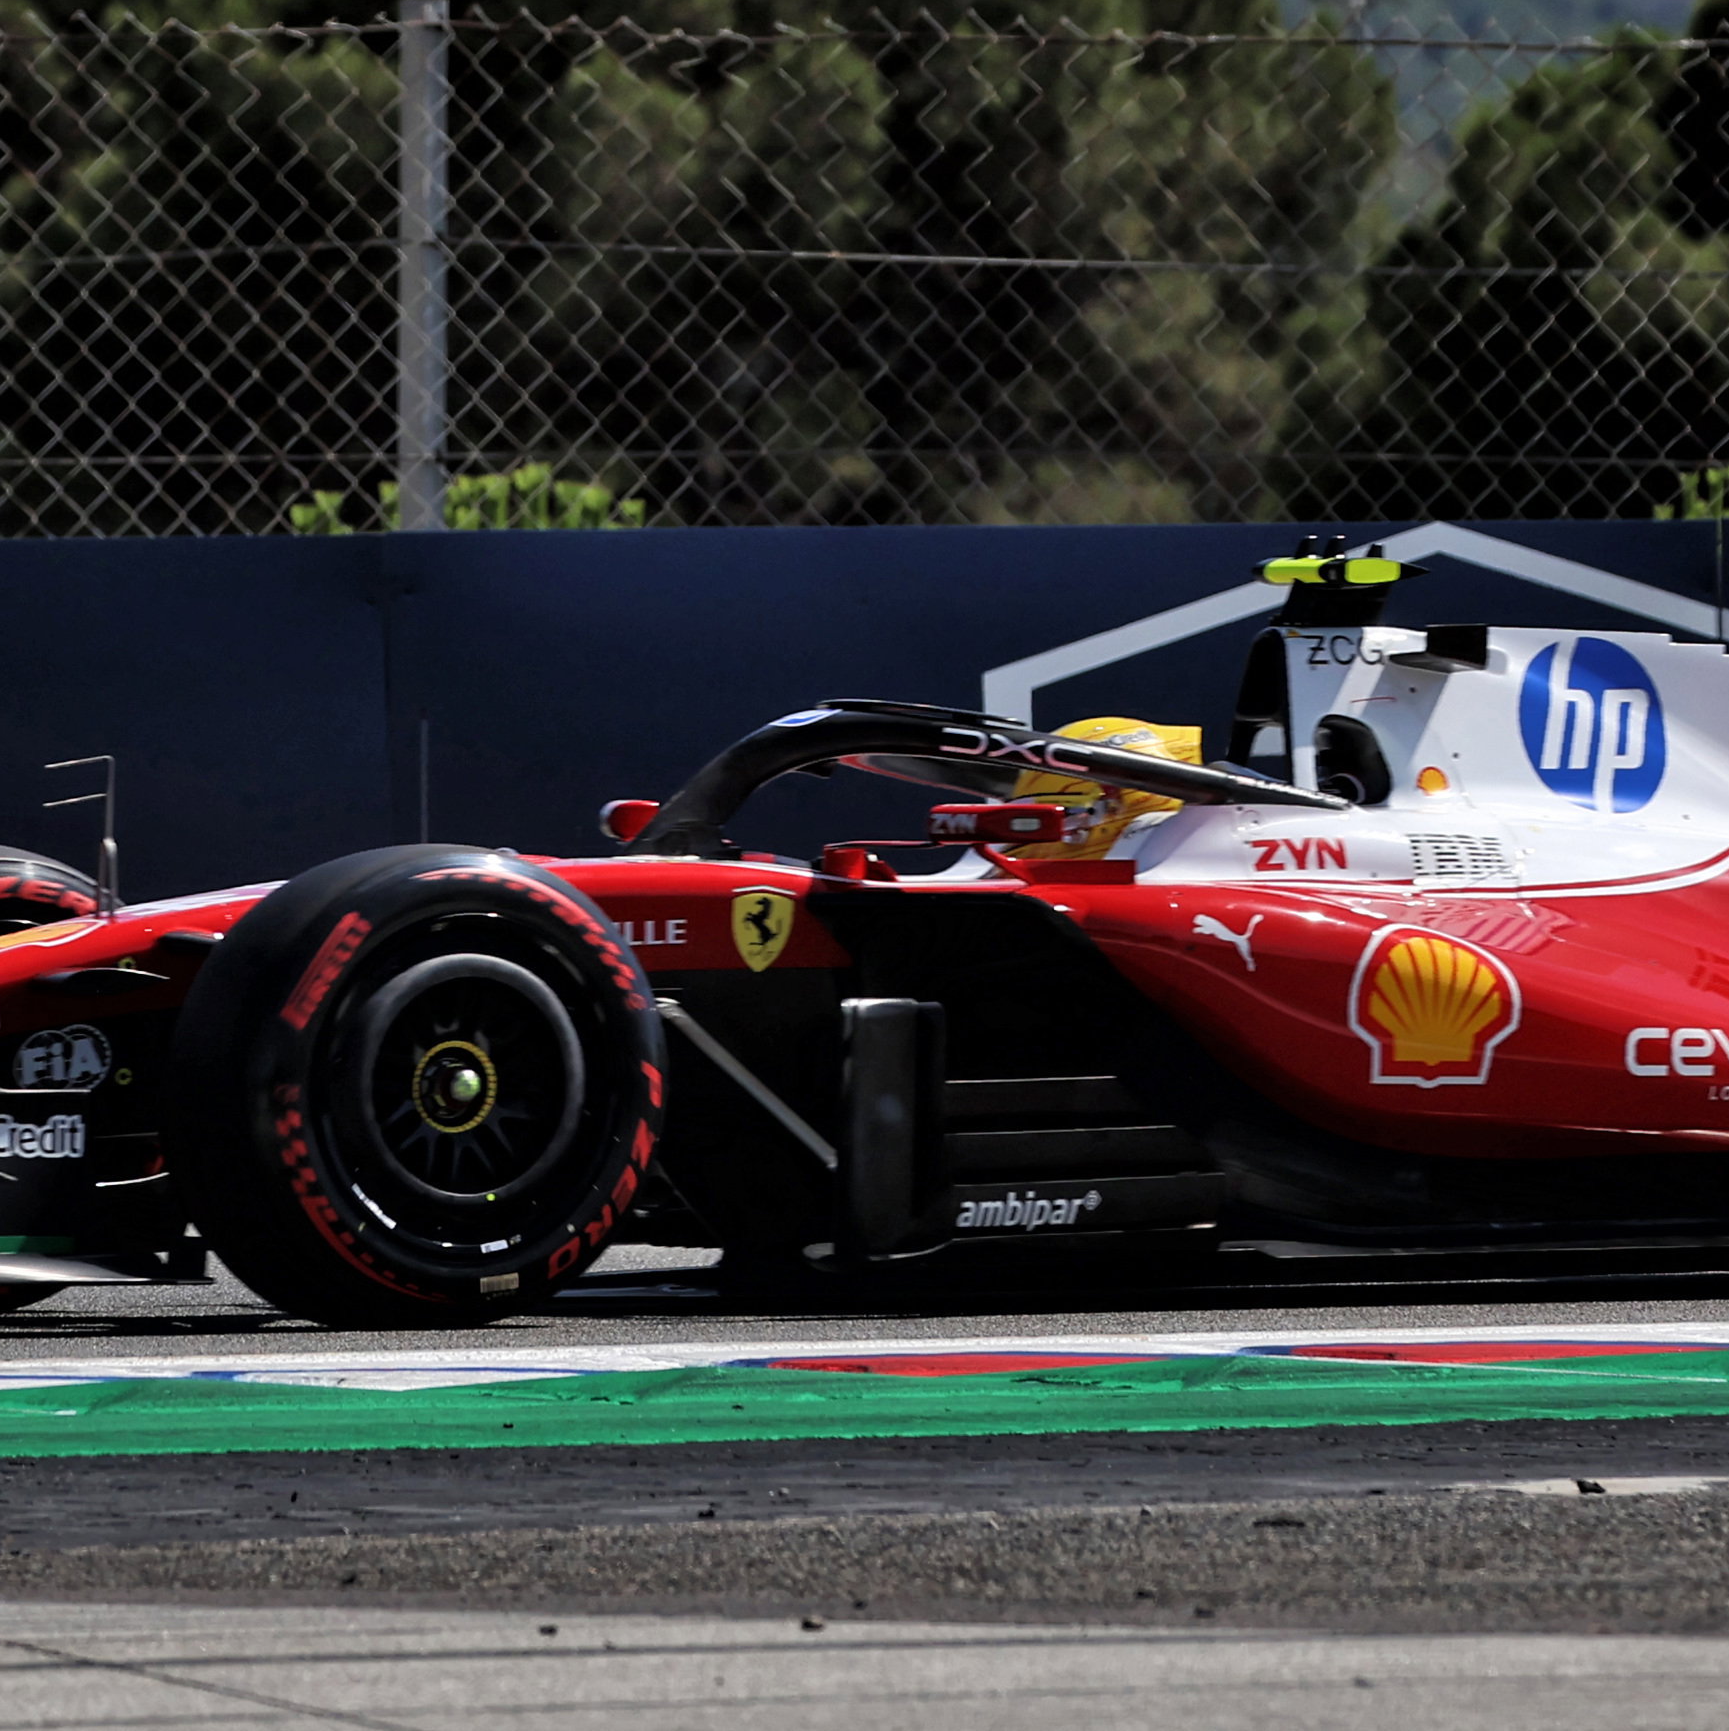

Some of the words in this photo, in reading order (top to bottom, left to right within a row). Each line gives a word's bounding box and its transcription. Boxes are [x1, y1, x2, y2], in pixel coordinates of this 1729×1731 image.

[1306, 634, 1383, 666] ZCG
[1539, 639, 1650, 814] hp
[939, 726, 1093, 772] DXC
[929, 812, 979, 836] ZYN
[1248, 837, 1348, 872] ZYN
[955, 1190, 1085, 1232] ambipar
